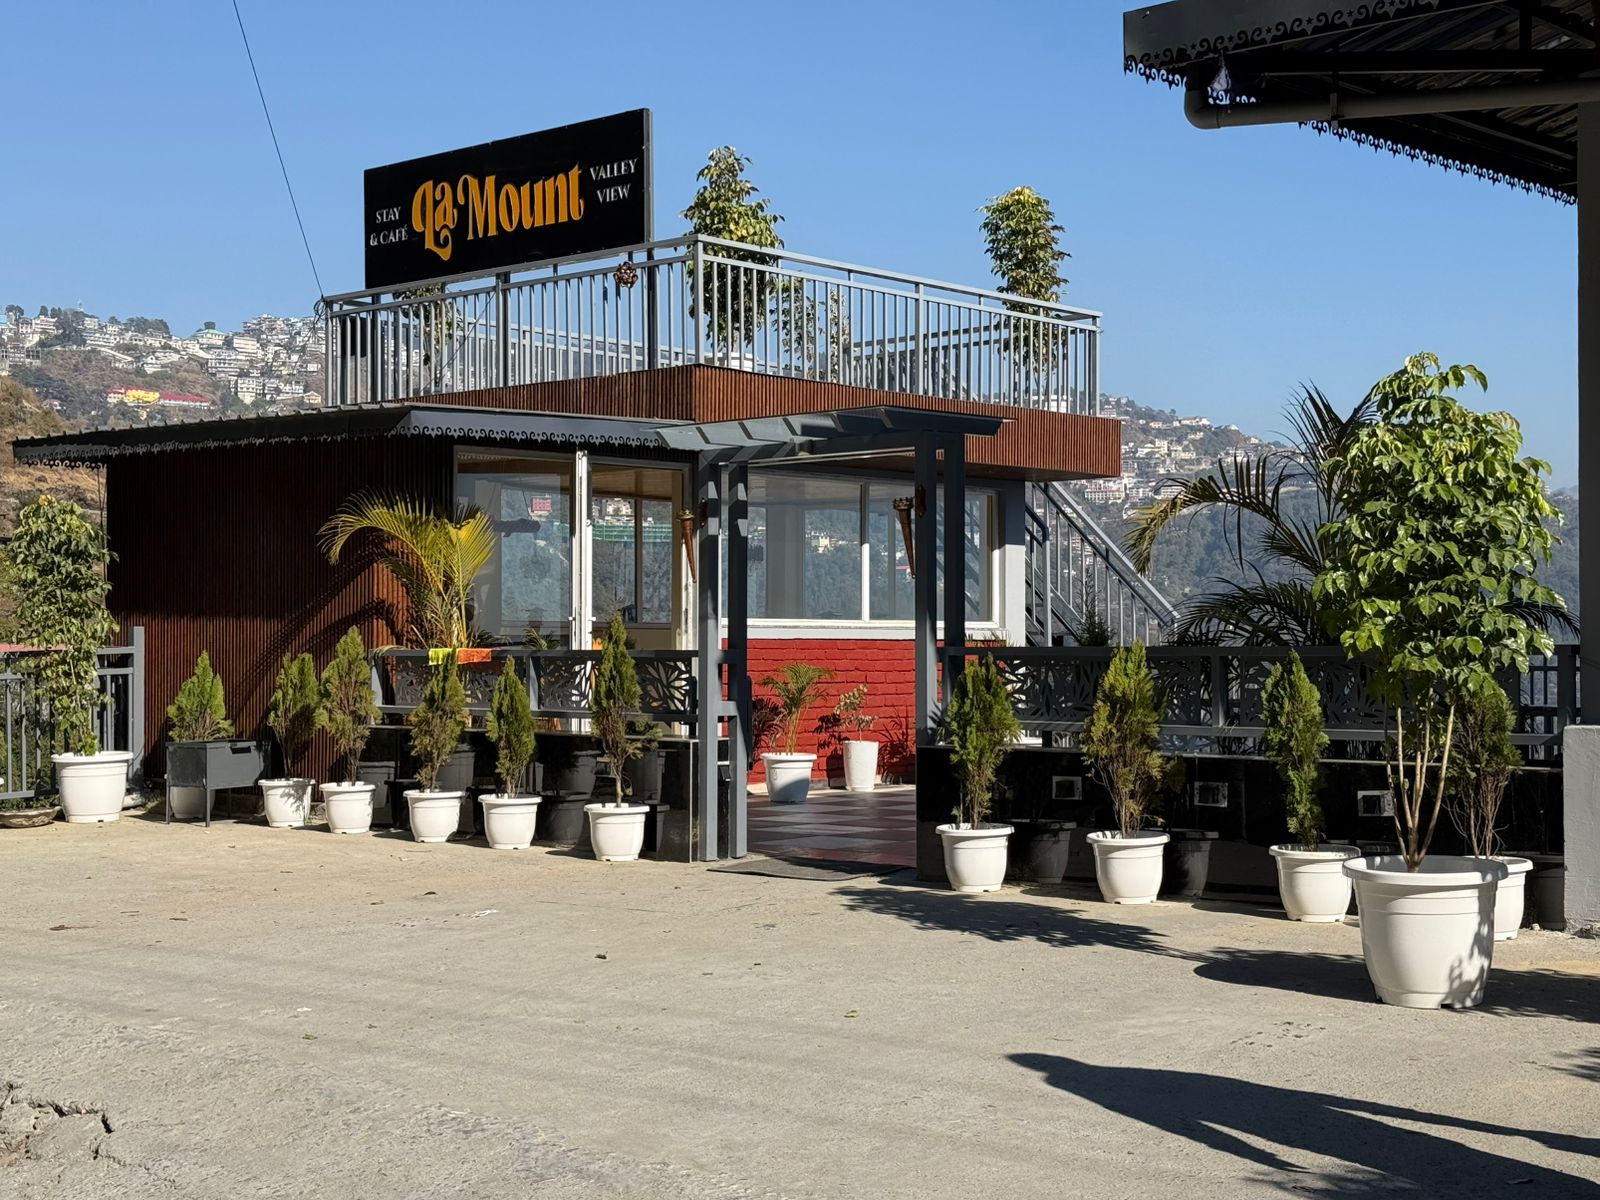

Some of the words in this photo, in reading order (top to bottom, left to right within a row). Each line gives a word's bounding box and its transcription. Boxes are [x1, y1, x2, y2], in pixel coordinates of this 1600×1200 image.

[589, 158, 639, 182] VALLEY
[596, 184, 632, 204] VIEW
[375, 206, 401, 224] STAY
[411, 179, 458, 262] La
[457, 162, 585, 241] Mount
[369, 232, 378, 246] &
[380, 225, 409, 245] CAFÉ
